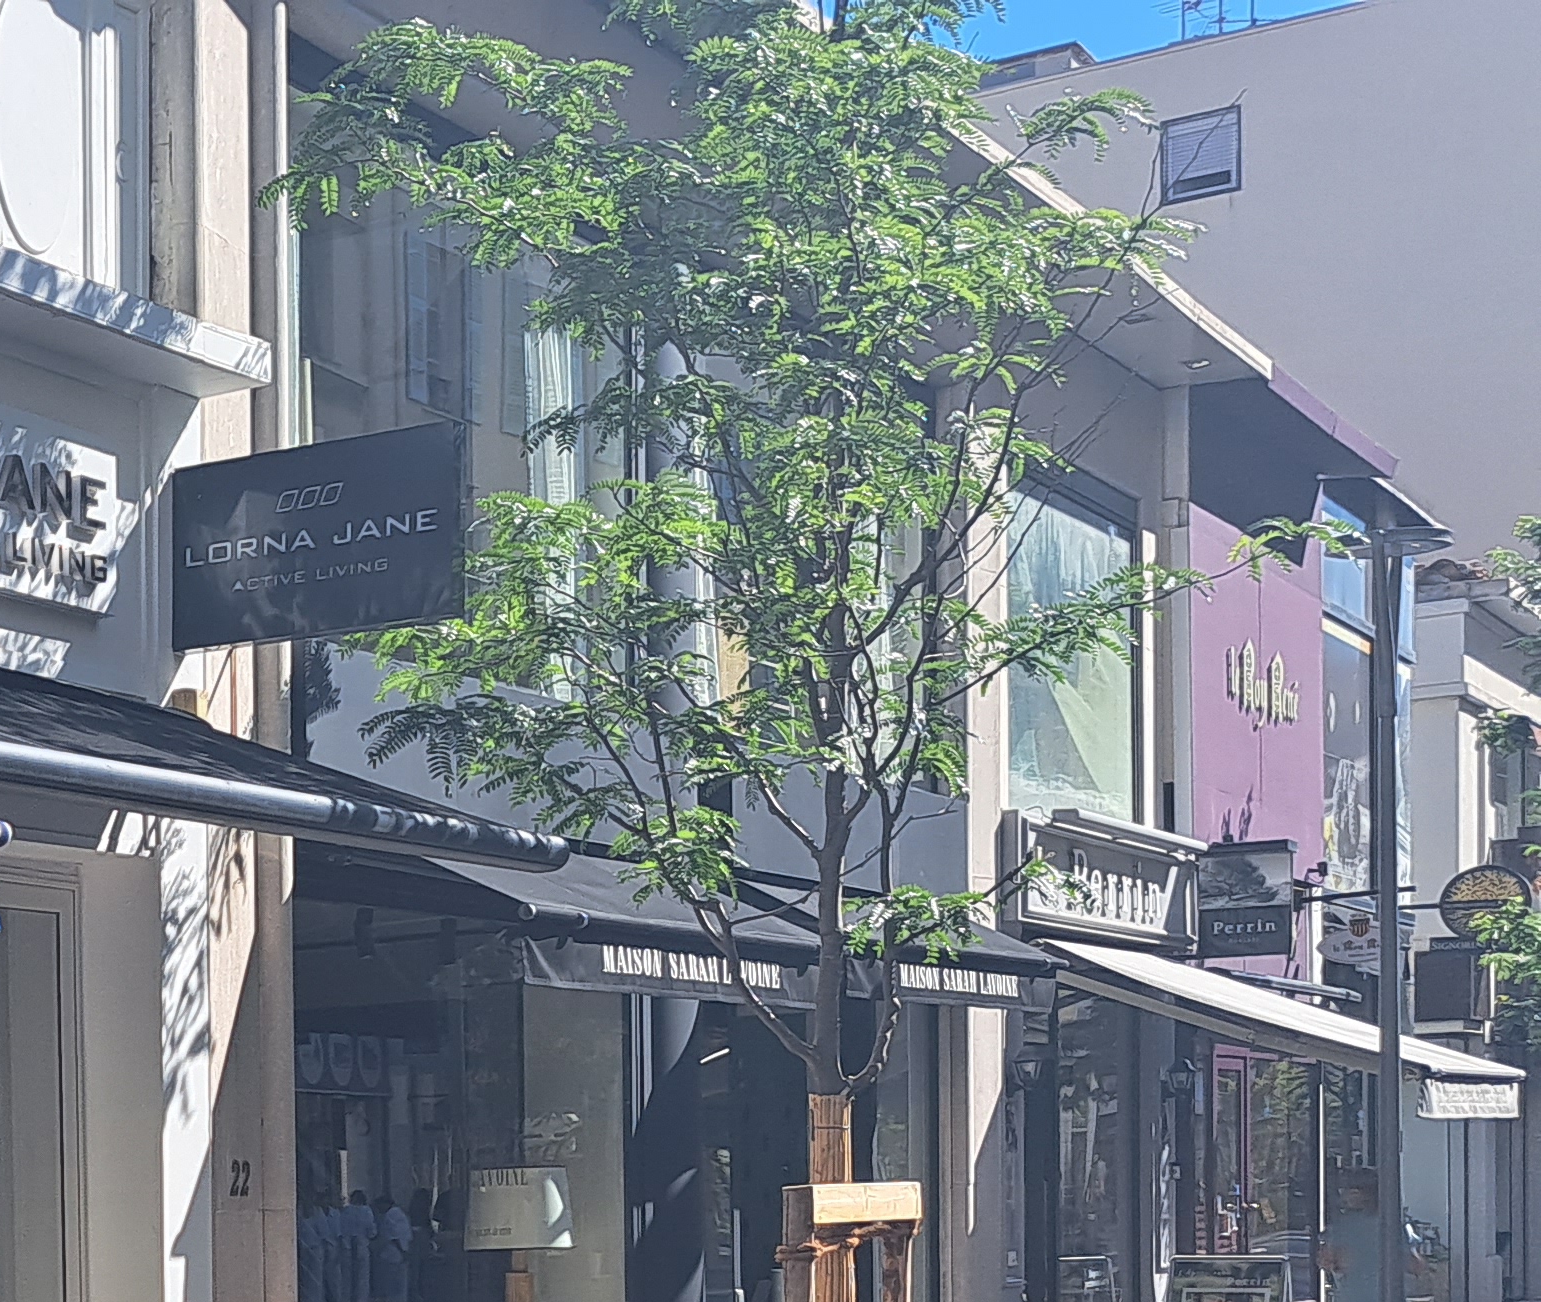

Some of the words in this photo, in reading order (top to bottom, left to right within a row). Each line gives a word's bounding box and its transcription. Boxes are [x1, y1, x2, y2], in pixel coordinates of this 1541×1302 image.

[8, 530, 108, 583] LIVING
[184, 529, 316, 569] LORNA
[332, 507, 439, 546] JANE
[231, 569, 306, 592] ACTIVE
[315, 557, 389, 582] LIVING
[1212, 919, 1277, 935] Perrin
[602, 944, 662, 978] MAISON
[668, 952, 717, 983] SARAH
[722, 957, 781, 989] LVOINE
[899, 963, 940, 991] MAISON
[942, 968, 977, 993] SARAH
[979, 971, 1019, 997] LAVOINE
[229, 1159, 251, 1197] 22
